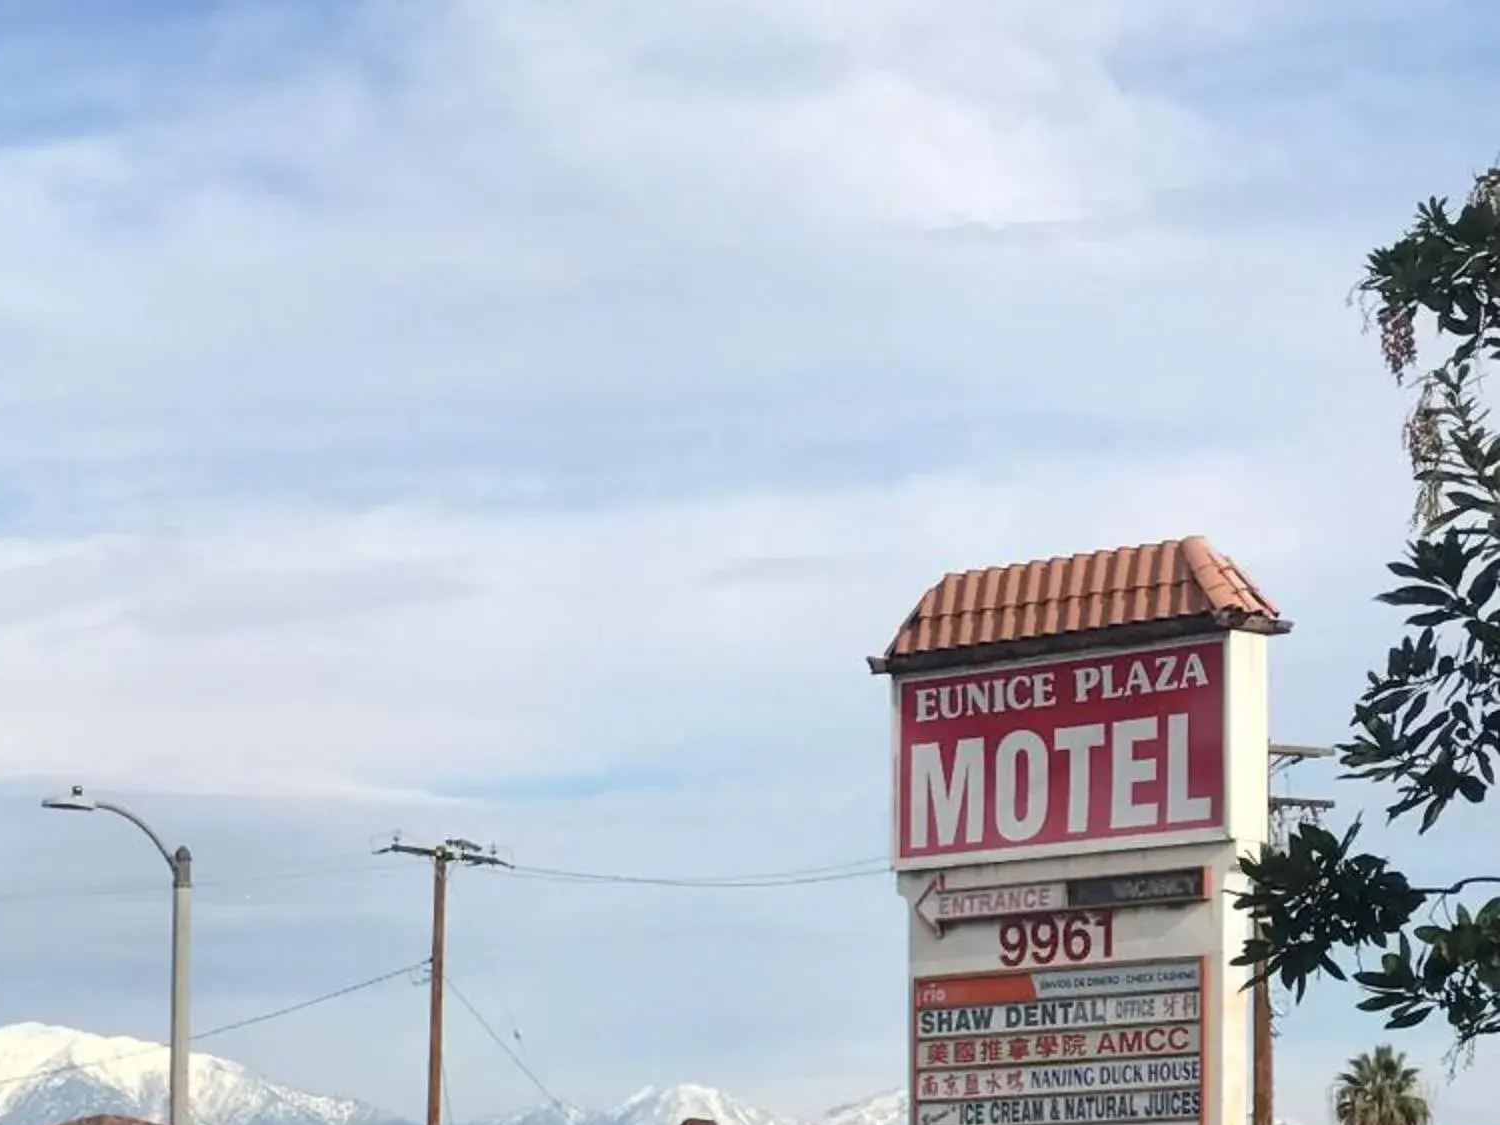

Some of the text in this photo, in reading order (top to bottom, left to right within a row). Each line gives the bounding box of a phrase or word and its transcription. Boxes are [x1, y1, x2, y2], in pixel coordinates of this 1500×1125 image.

[915, 652, 1210, 723] EUNICE PLAZA
[910, 712, 1212, 849] MOTEL
[938, 888, 1049, 915] ENTRANCE
[999, 909, 1113, 967] 9961
[921, 1007, 994, 1033] SHAW
[1006, 1000, 1105, 1028] DENTAL
[1097, 1026, 1190, 1055] AMCC
[1031, 1066, 1095, 1089] NANJING
[1100, 1063, 1144, 1085] DUCK
[1148, 1060, 1199, 1082] HOUSE
[959, 1103, 985, 1125] ICE
[990, 1100, 1044, 1123] CREAM
[1049, 1097, 1061, 1121] &
[1065, 1093, 1139, 1121] NATURAL
[1144, 1090, 1200, 1116] JUICES
